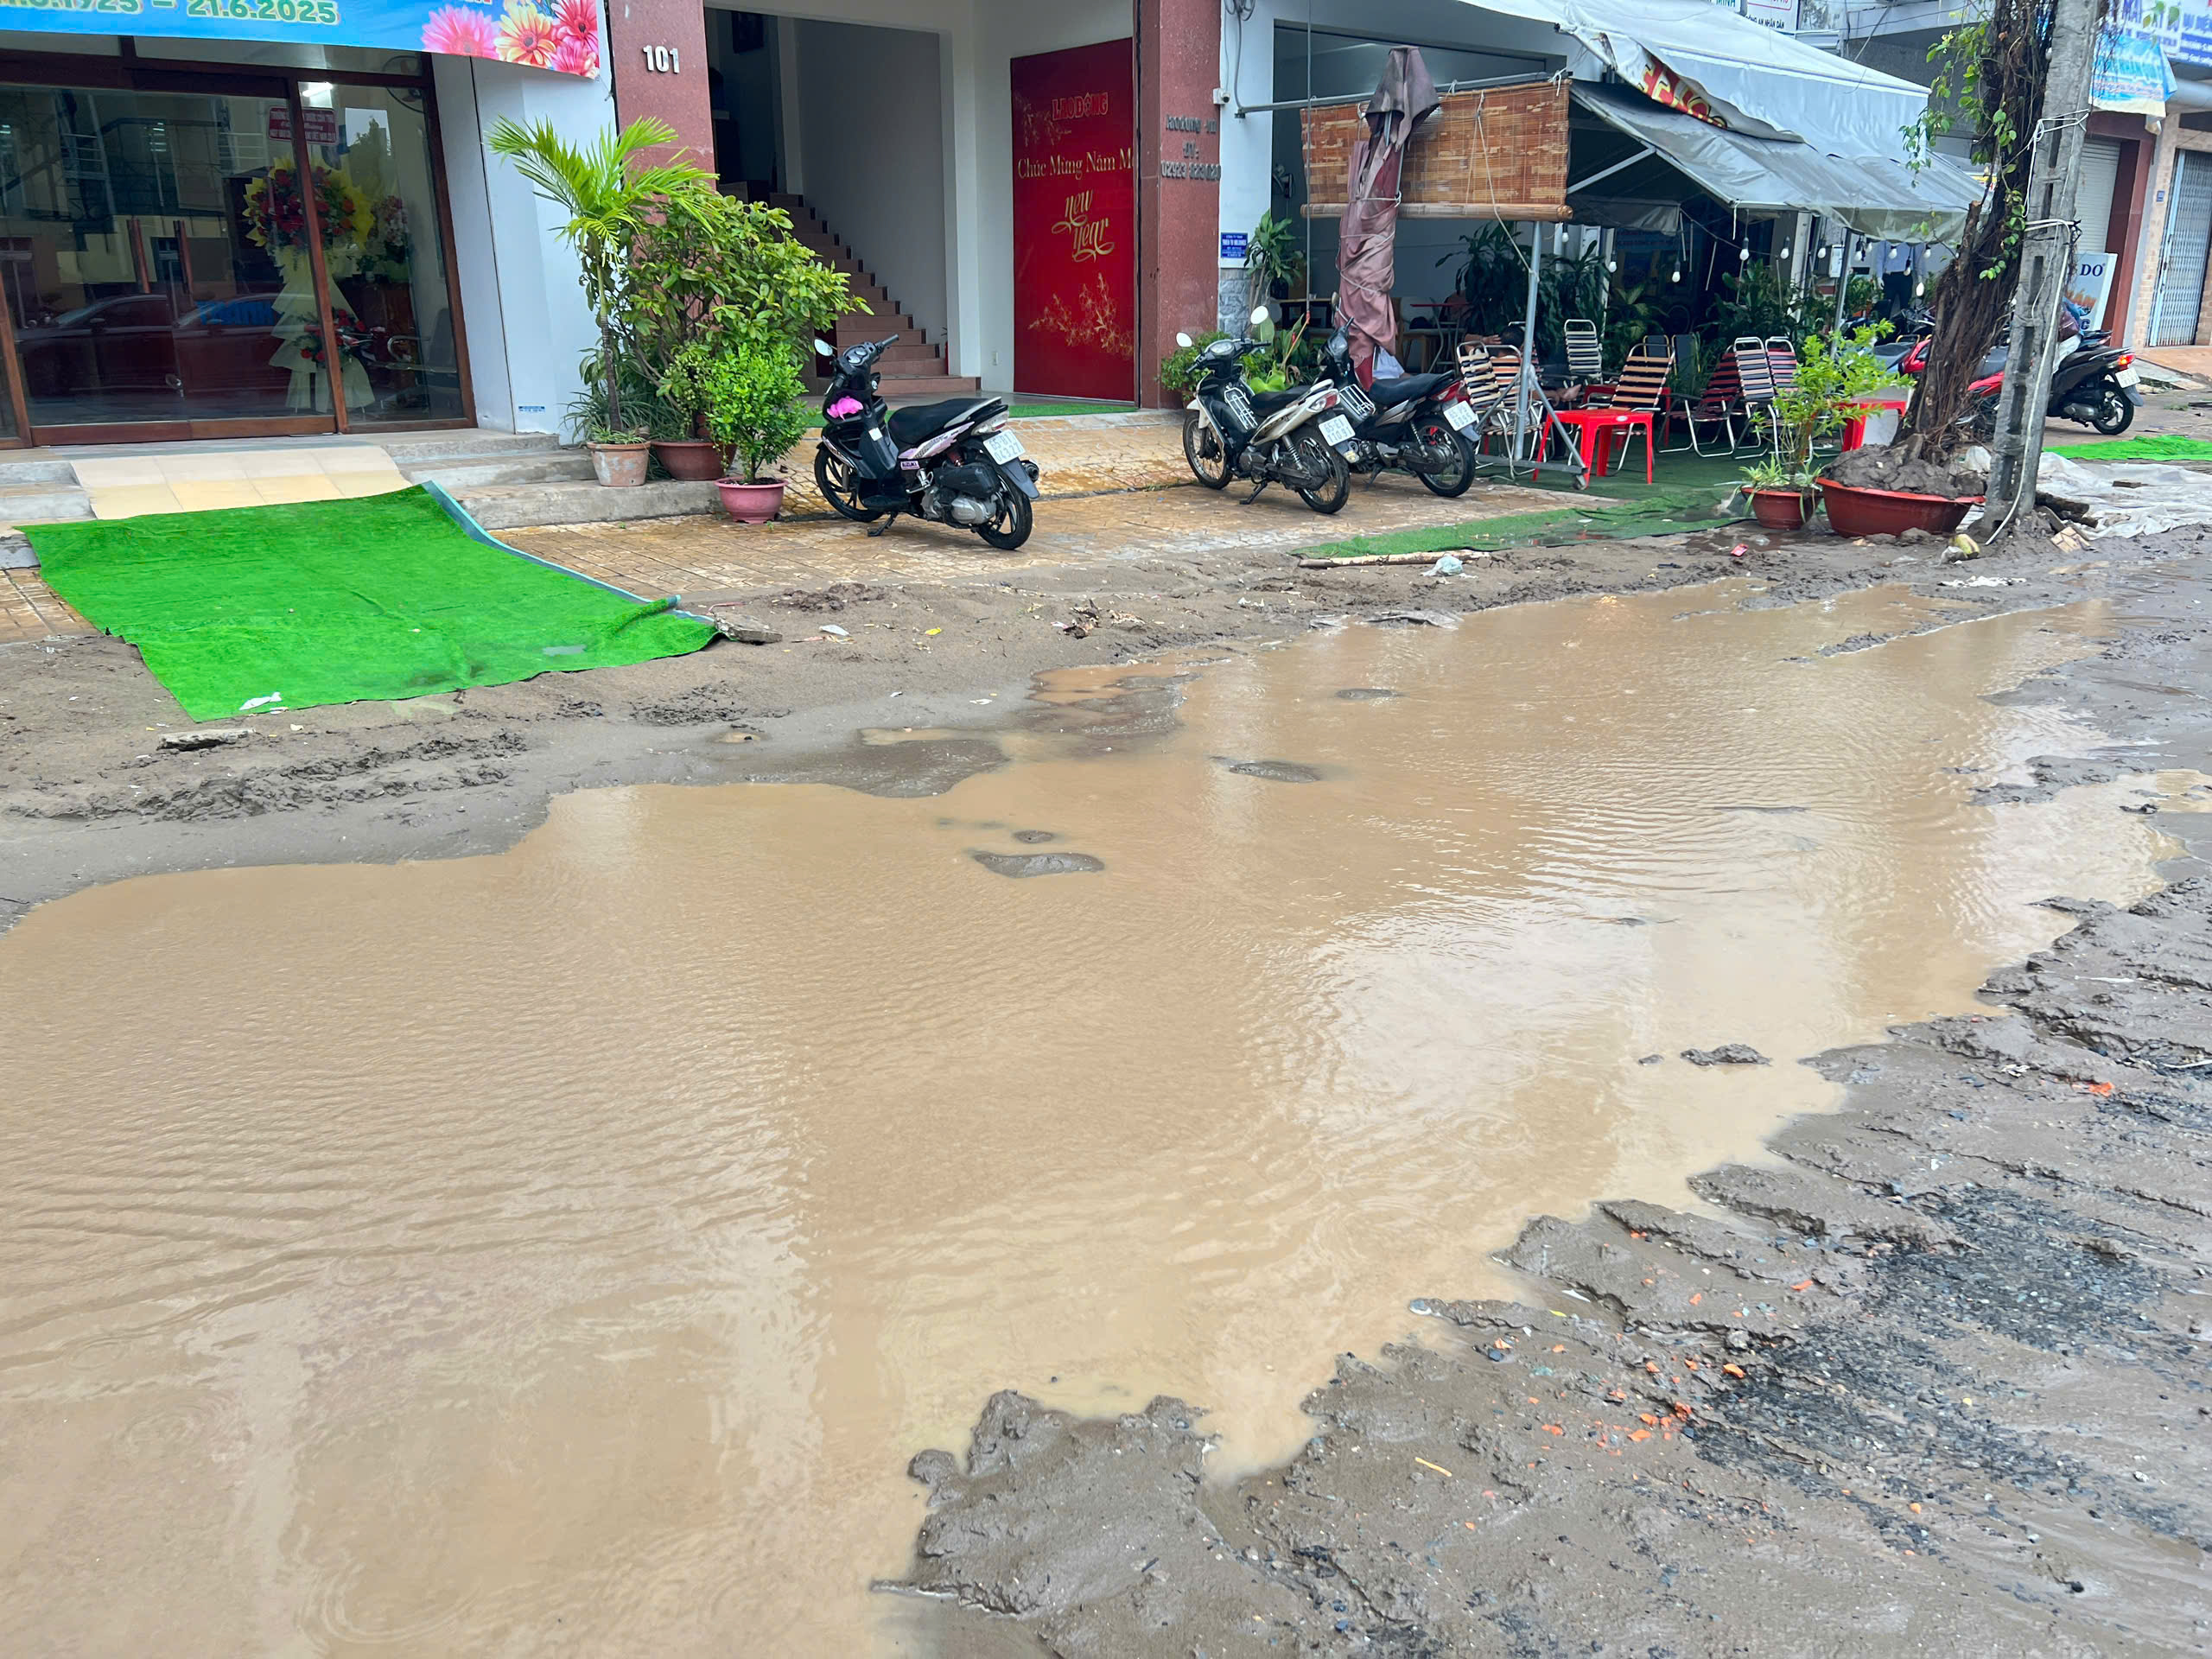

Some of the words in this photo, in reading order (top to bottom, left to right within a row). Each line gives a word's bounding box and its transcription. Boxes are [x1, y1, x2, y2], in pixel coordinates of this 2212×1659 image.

[188, 0, 339, 23] 21.6.2025
[642, 44, 681, 74] 101
[1018, 158, 1046, 179] Chúc
[1085, 150, 1116, 173] Năm
[1161, 161, 1187, 179] 02923
[1052, 189, 1094, 235] new
